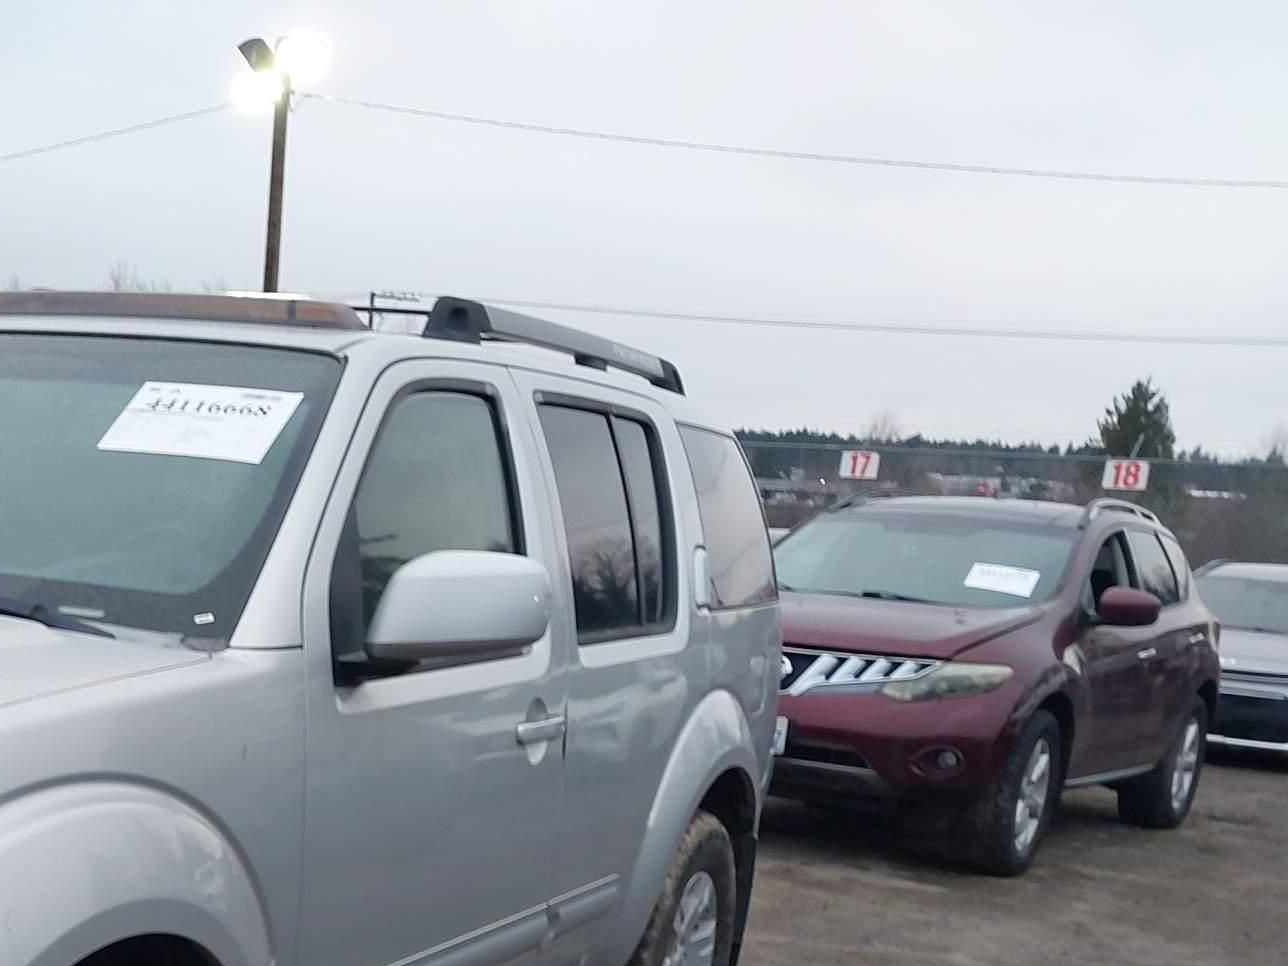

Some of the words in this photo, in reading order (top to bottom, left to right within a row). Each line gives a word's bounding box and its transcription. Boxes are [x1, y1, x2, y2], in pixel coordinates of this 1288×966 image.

[146, 397, 271, 417] 44116668
[850, 453, 873, 477] 17
[1113, 460, 1141, 489] 18
